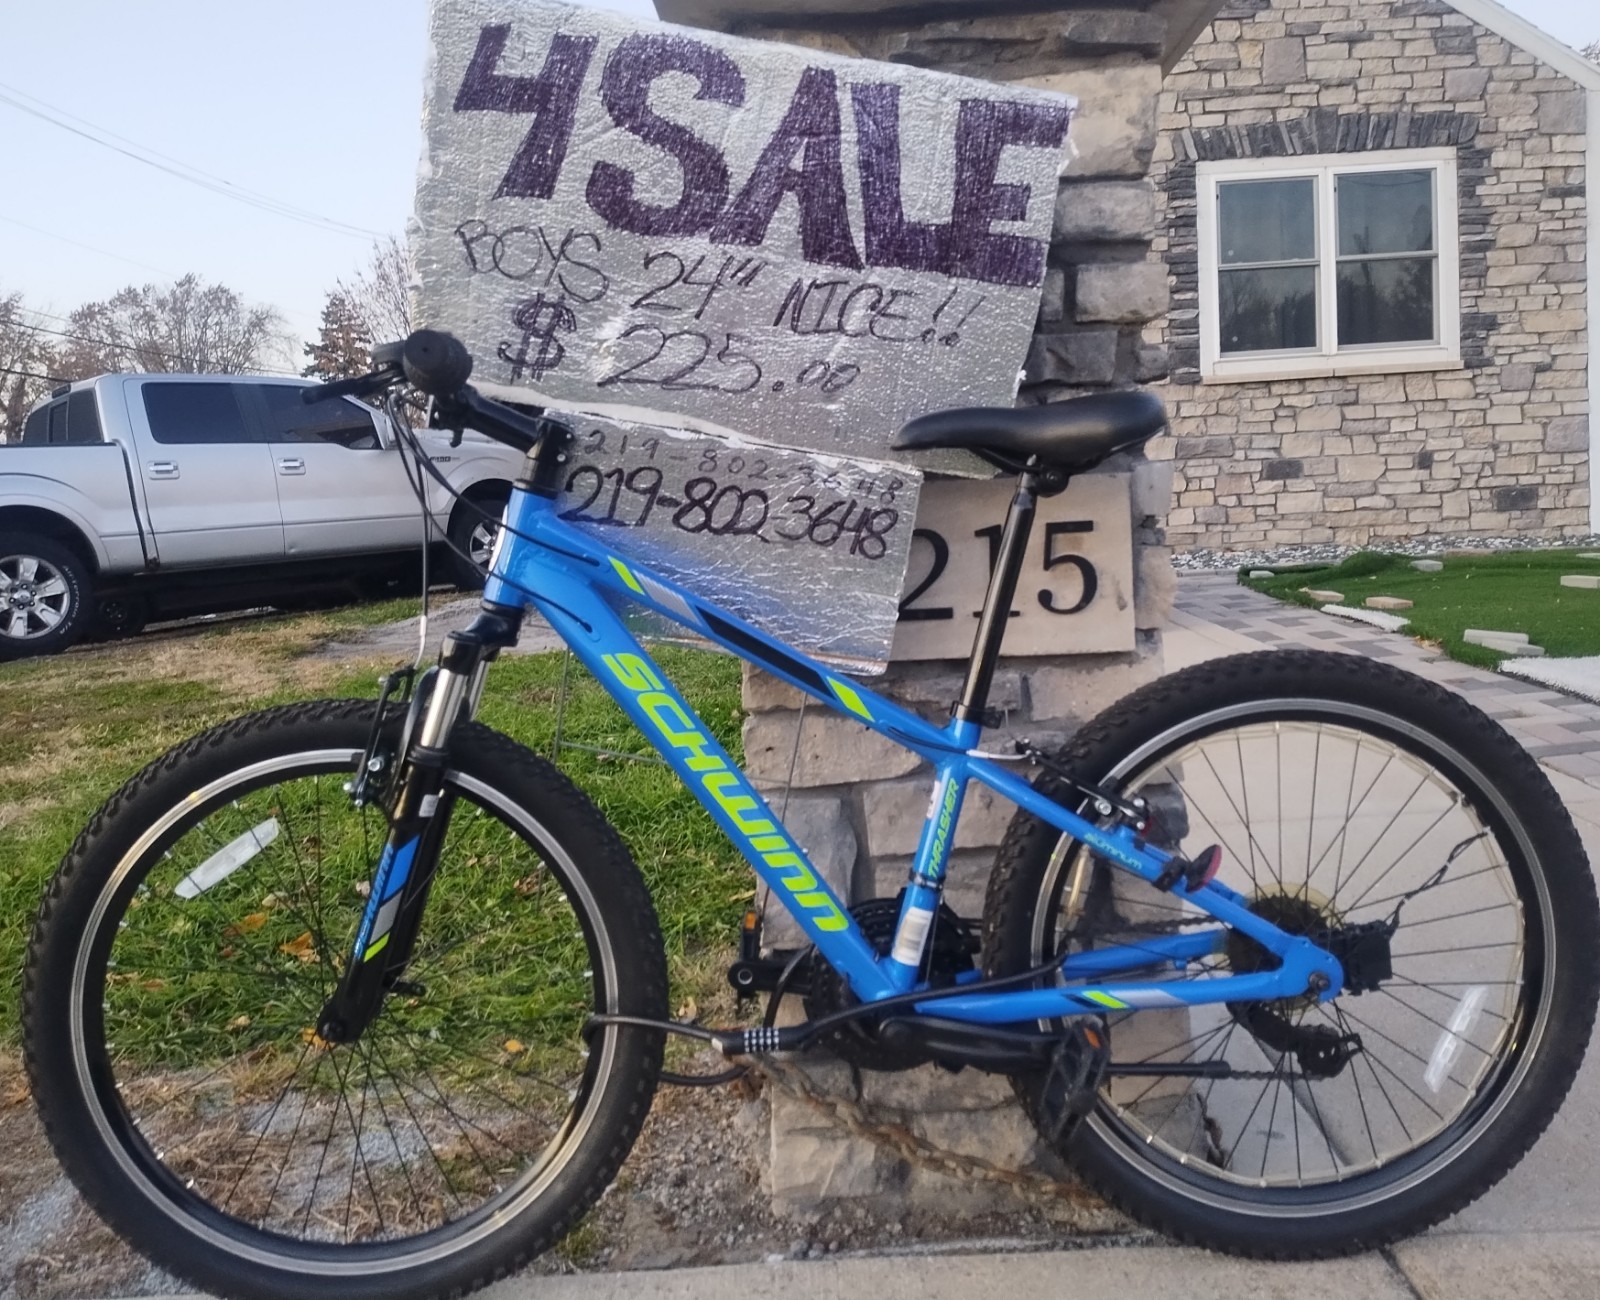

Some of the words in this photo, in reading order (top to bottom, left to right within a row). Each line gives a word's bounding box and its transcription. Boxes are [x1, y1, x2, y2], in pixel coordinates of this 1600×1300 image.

[454, 219, 610, 303] BOYS
[772, 276, 988, 348] NICE!!
[597, 323, 861, 395] 225.00
[927, 777, 960, 879] THRASHER
